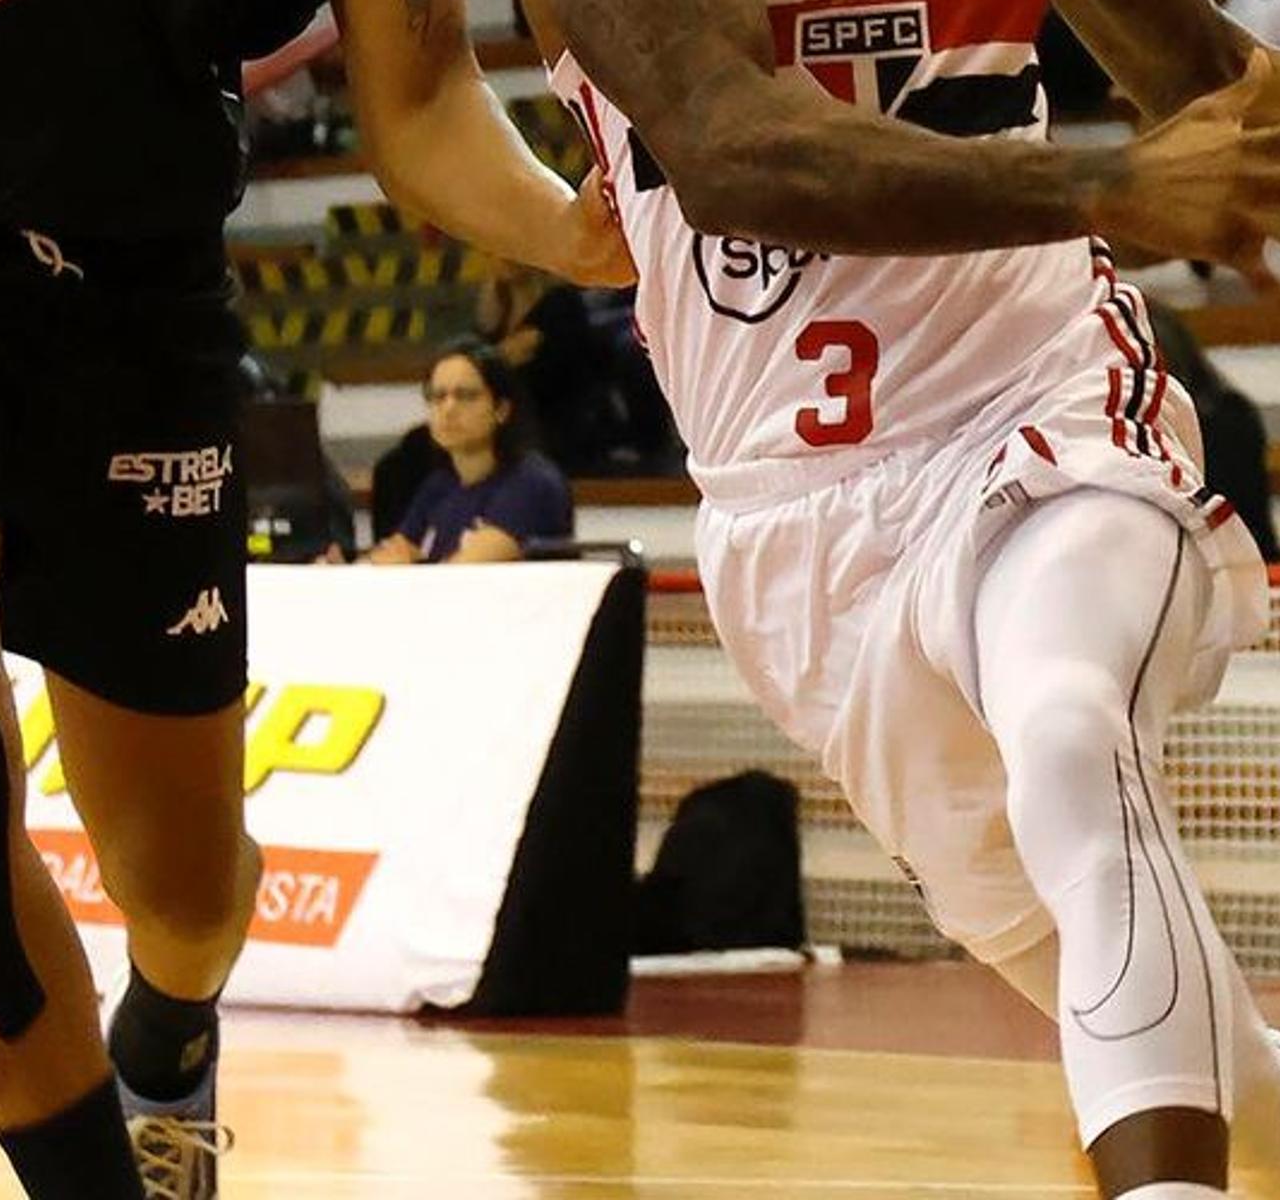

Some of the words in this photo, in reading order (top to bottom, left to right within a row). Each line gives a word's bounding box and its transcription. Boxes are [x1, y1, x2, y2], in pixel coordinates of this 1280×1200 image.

[808, 13, 920, 51] SPFC
[795, 320, 879, 446] 3
[172, 482, 223, 516] BET
